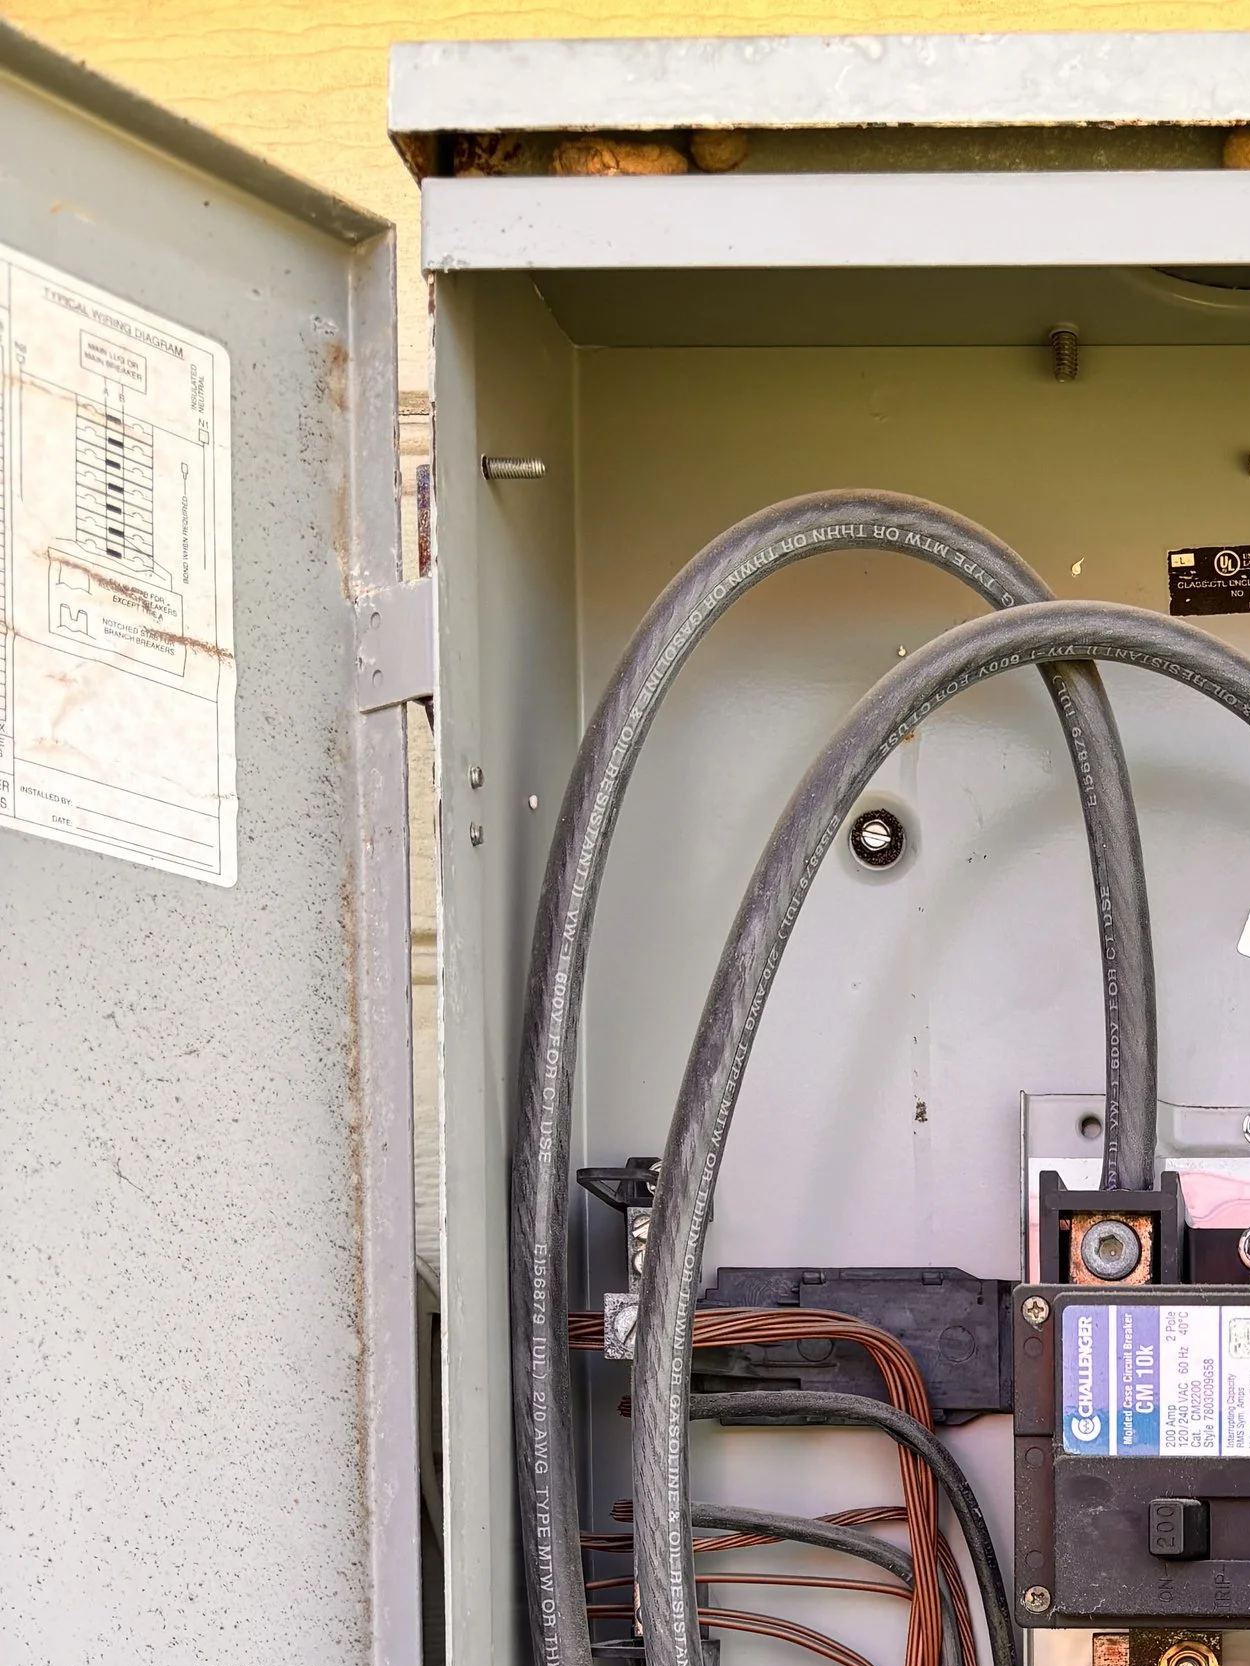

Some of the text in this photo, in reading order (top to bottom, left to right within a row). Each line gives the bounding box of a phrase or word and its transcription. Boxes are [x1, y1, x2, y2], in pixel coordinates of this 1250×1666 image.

[43, 285, 186, 359] TYPICAL WIRING DIAGRAM
[105, 359, 143, 382] BREAKER
[109, 349, 127, 365] LUG
[190, 363, 198, 411] INSULATED
[197, 374, 205, 414] NEUTRAL
[102, 617, 138, 636] NOTCHED
[135, 634, 176, 656] BREAKERS
[19, 784, 60, 803] INSTALLED
[60, 797, 73, 808] BY:
[51, 814, 73, 828] DATE:
[538, 524, 999, 1163] TYPE MTW OR THHN OR THWN OR GASOLINE OIL RESISTANT FOR CT USE
[745, 983, 767, 1031] AWG
[724, 1042, 748, 1097] TYPE
[711, 1100, 732, 1147] MTW
[688, 1188, 710, 1247] THHN
[533, 1243, 547, 1324] E156879
[674, 1291, 691, 1350] THWN
[1165, 1311, 1176, 1332] Pole
[670, 1357, 684, 1385] OR
[1078, 1316, 1093, 1418] CHALLENGER
[1122, 1313, 1133, 1445] Molded Case Circuit Breaker
[1135, 1344, 1154, 1414] CM 10k
[1178, 1311, 1189, 1448] 120/240 VAC 60 Hz 40°C
[531, 1391, 546, 1422] 2/0
[1191, 1380, 1201, 1448] Cat. CM2200
[1226, 1373, 1237, 1448] Interrupting Capacity
[1236, 1387, 1246, 1408] Amps
[668, 1393, 683, 1501] GASOLINE
[1165, 1404, 1178, 1448] 200 Amp
[1203, 1424, 1215, 1448] Style
[1236, 1430, 1245, 1448] RMS
[534, 1428, 549, 1474] AWG
[535, 1486, 551, 1538] TYPE
[1156, 1505, 1175, 1549] 200
[538, 1549, 554, 1598] MTW
[1160, 1578, 1173, 1604] ON
[1214, 1574, 1231, 1610] TRIP
[541, 1598, 557, 1628] OR
